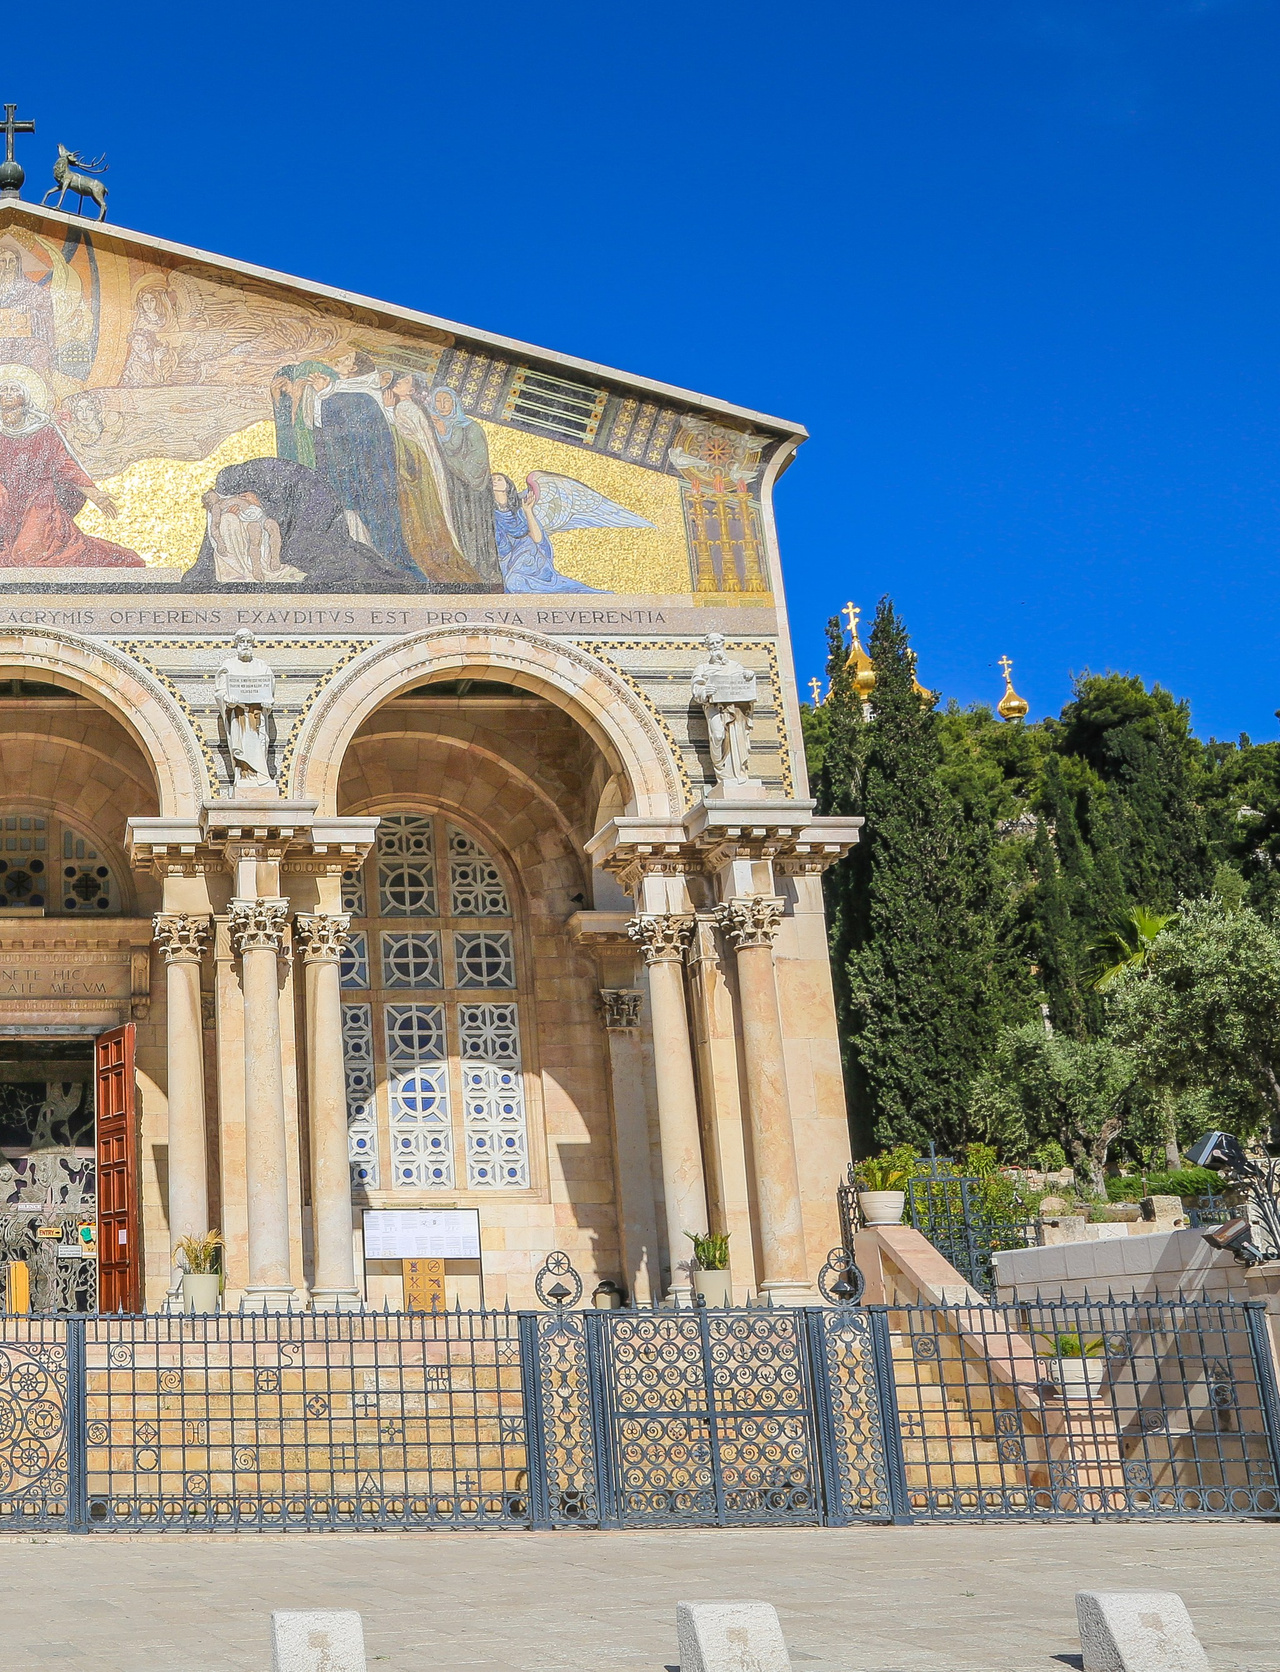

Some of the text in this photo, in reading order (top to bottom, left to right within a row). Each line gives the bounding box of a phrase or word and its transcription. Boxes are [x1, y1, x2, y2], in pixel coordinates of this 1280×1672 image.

[110, 611, 221, 624] OFFERENS
[237, 610, 355, 624] EXAVDITVS
[371, 611, 411, 624] EST
[426, 611, 468, 624] PRO
[484, 611, 524, 624] SVA
[536, 610, 666, 624] REVERENTIA
[53, 969, 81, 980] HIC
[50, 982, 107, 994] MECVM
[39, 1229, 55, 1237] ENTRY
